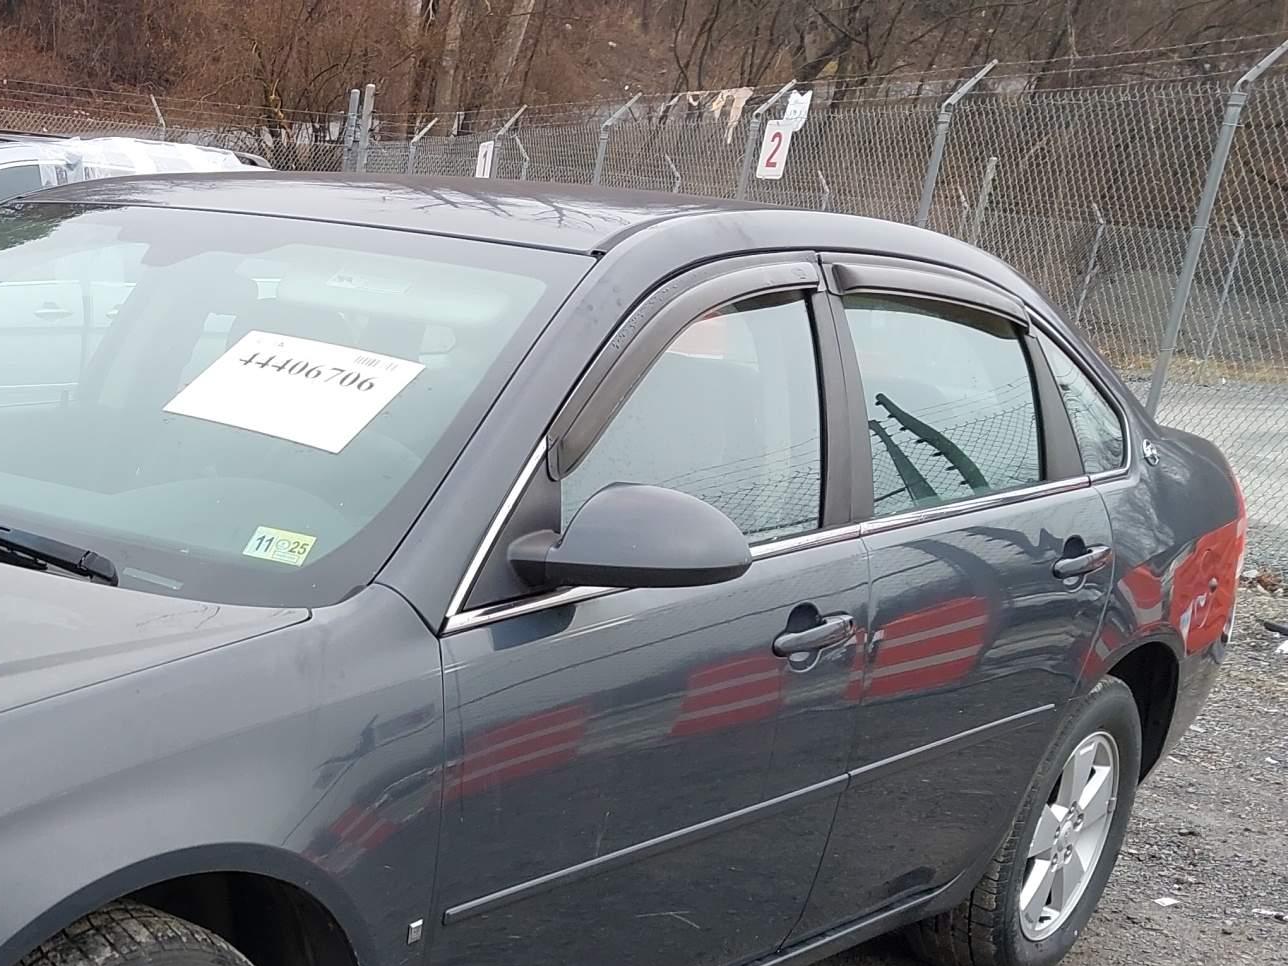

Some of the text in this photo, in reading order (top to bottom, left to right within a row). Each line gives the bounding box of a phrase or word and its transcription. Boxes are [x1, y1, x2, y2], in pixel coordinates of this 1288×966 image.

[764, 131, 783, 168] 2
[239, 352, 376, 393] 44406706
[255, 534, 310, 556] 11 25
